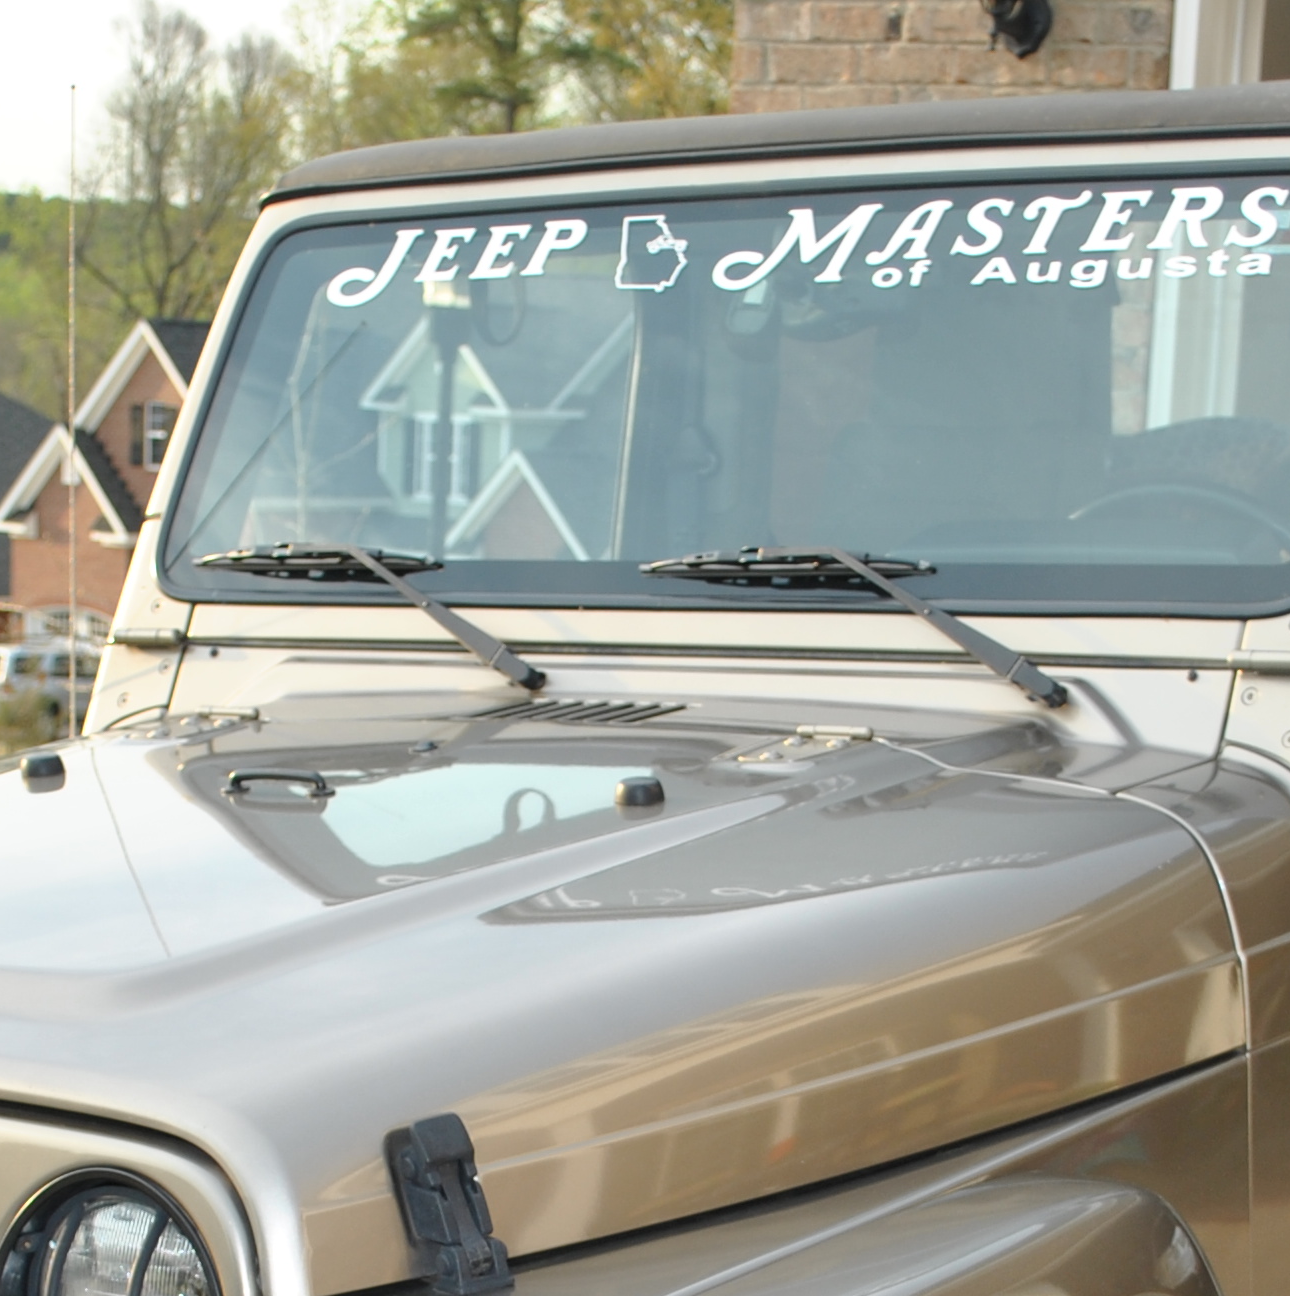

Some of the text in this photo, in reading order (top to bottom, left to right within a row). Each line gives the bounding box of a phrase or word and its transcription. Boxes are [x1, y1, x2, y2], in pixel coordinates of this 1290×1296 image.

[326, 186, 1290, 308] JEEP MASTERS
[871, 249, 1272, 289] of Augusta
